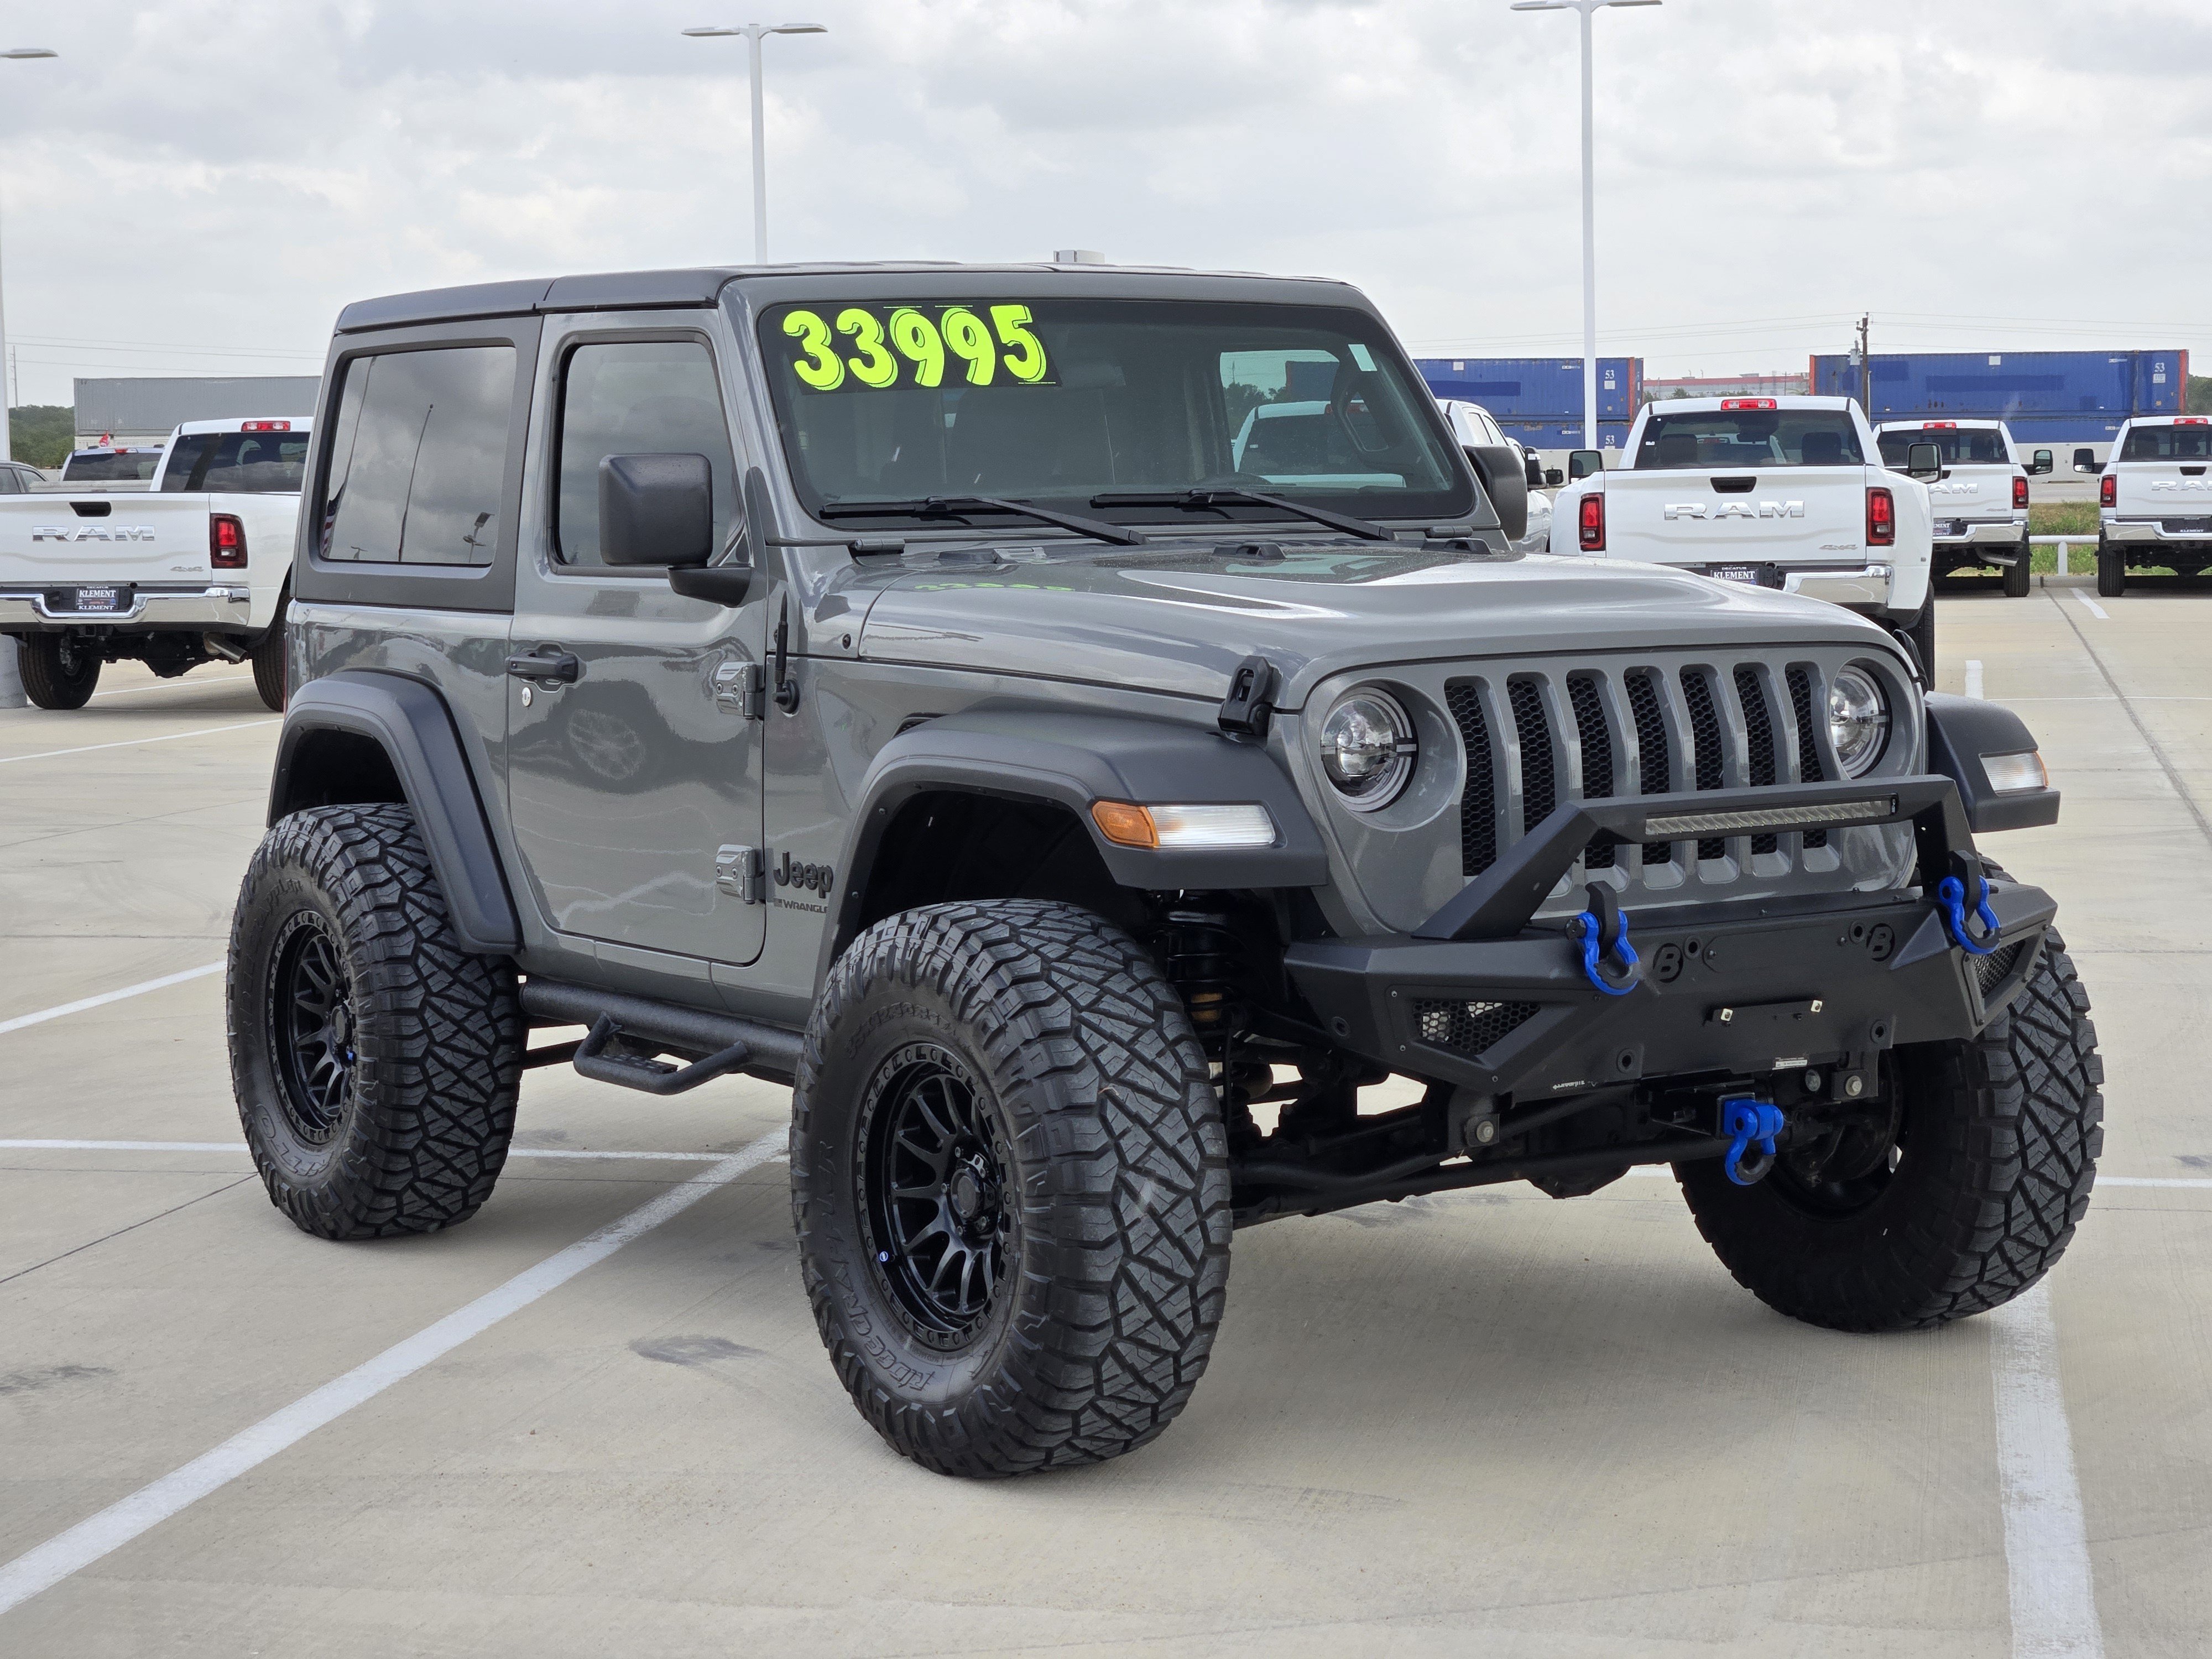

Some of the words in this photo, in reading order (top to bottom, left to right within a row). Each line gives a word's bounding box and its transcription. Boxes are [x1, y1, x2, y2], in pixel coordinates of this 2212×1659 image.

[782, 304, 1047, 390] 33995
[2154, 362, 2165, 372] 53
[1605, 370, 1615, 379] 53
[1605, 435, 1615, 444] 53
[1928, 483, 1978, 494] AM
[2152, 480, 2212, 491] RA
[1663, 500, 1805, 520] RAM
[32, 525, 156, 542] RAM
[1714, 571, 1755, 580] KLEMENT
[79, 589, 116, 598] KLEMENT
[773, 851, 833, 899] Jeep
[782, 899, 828, 914] WRANGL
